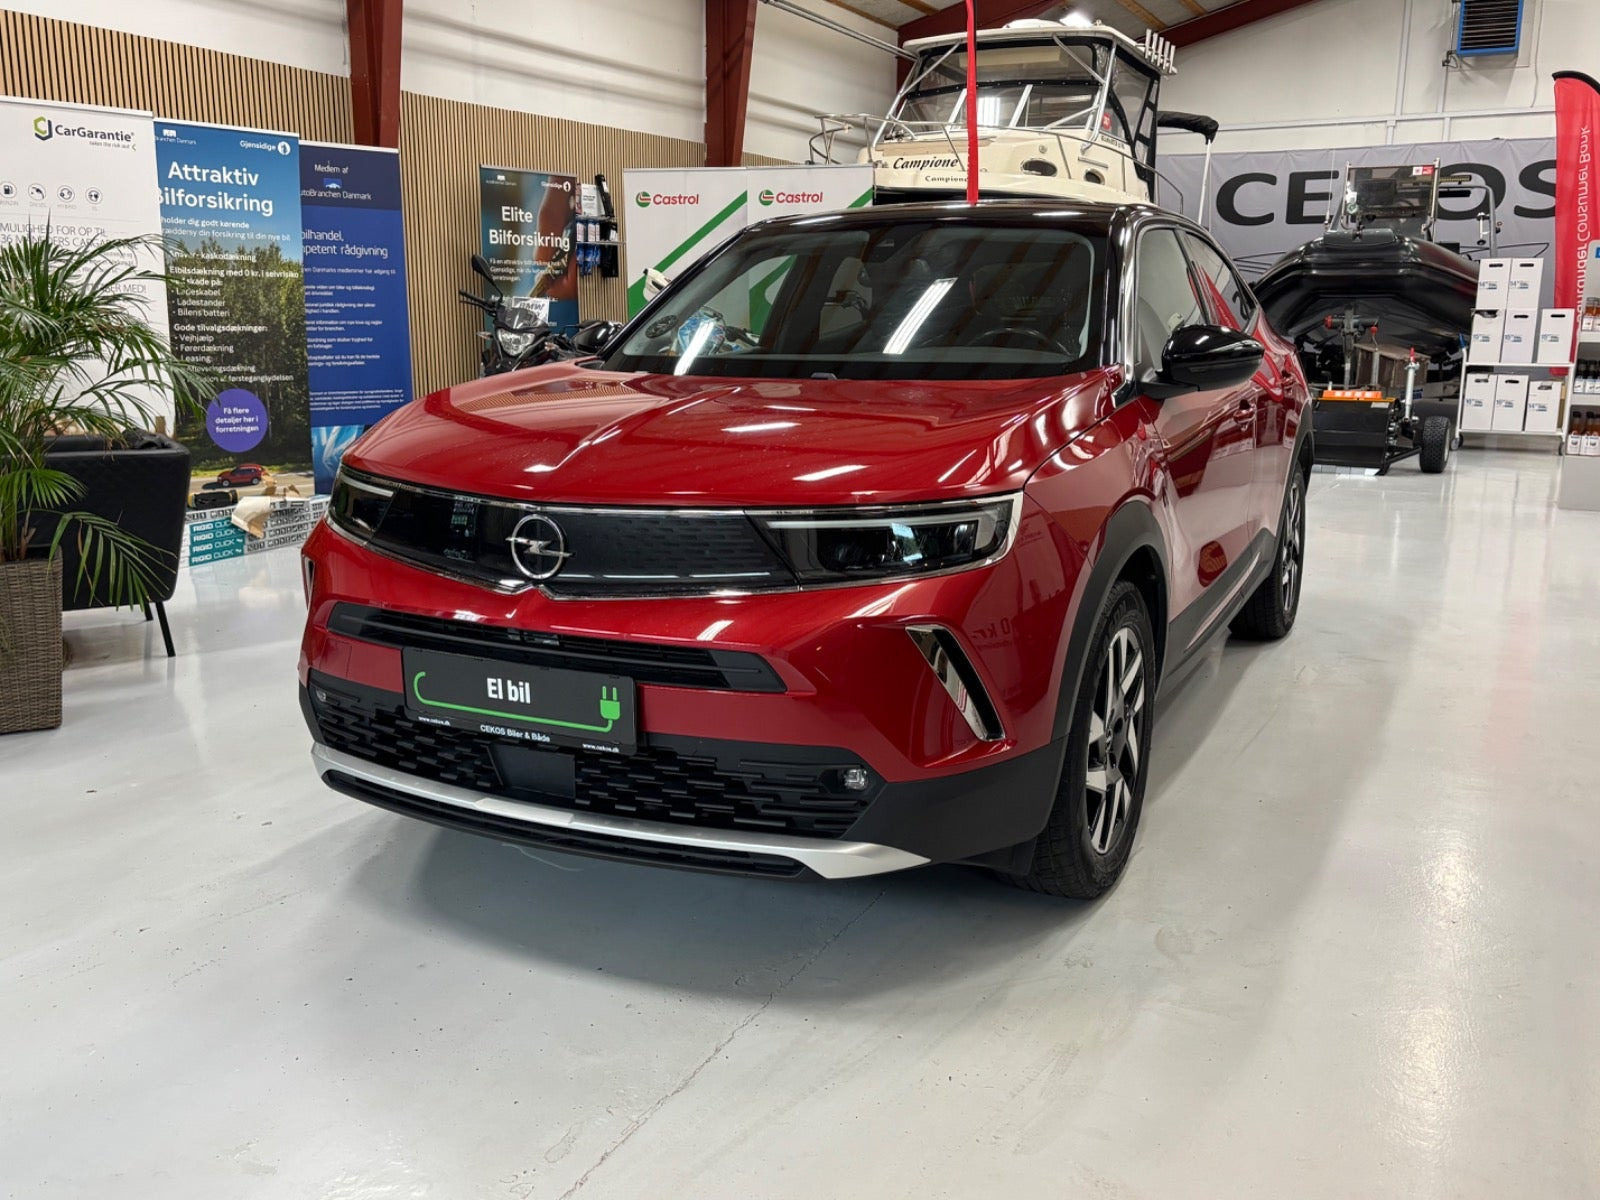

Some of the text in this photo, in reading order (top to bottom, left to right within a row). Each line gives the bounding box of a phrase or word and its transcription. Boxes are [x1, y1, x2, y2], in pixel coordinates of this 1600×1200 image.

[240, 140, 276, 151] Gjensidige
[314, 162, 349, 174] Medlem af
[893, 156, 959, 170] Campione
[168, 161, 259, 186] Attraktiv
[300, 189, 372, 200] utoBranchen Danmark
[776, 192, 823, 204] Castrol
[1216, 160, 1557, 227] CEOS
[653, 194, 699, 206] Castrol
[501, 206, 533, 223] Elite
[188, 217, 200, 227] dig
[201, 219, 219, 228] godt
[220, 220, 249, 229] kørende
[0, 222, 54, 235] MULIGHED
[56, 225, 76, 236] FOR
[78, 226, 93, 236] OP
[198, 229, 210, 237] din
[212, 229, 246, 240] forsikring
[489, 229, 570, 251] Bilforsikring
[303, 244, 388, 259] petent rådgivning
[169, 266, 225, 277] Elbilsdækning
[226, 268, 243, 277] med
[177, 298, 225, 307] Ladestander
[177, 307, 230, 317] Bilens batteri
[174, 323, 195, 331] Gode
[179, 334, 214, 343] Vejhjælp
[180, 343, 234, 353] Førerdækning
[181, 354, 211, 364] Leasing
[215, 416, 242, 425] detaljer
[215, 425, 259, 433] forretningen
[215, 520, 232, 529] CLIC
[486, 677, 531, 704] El bil
[480, 724, 551, 743] CEKOS Biler & Både
